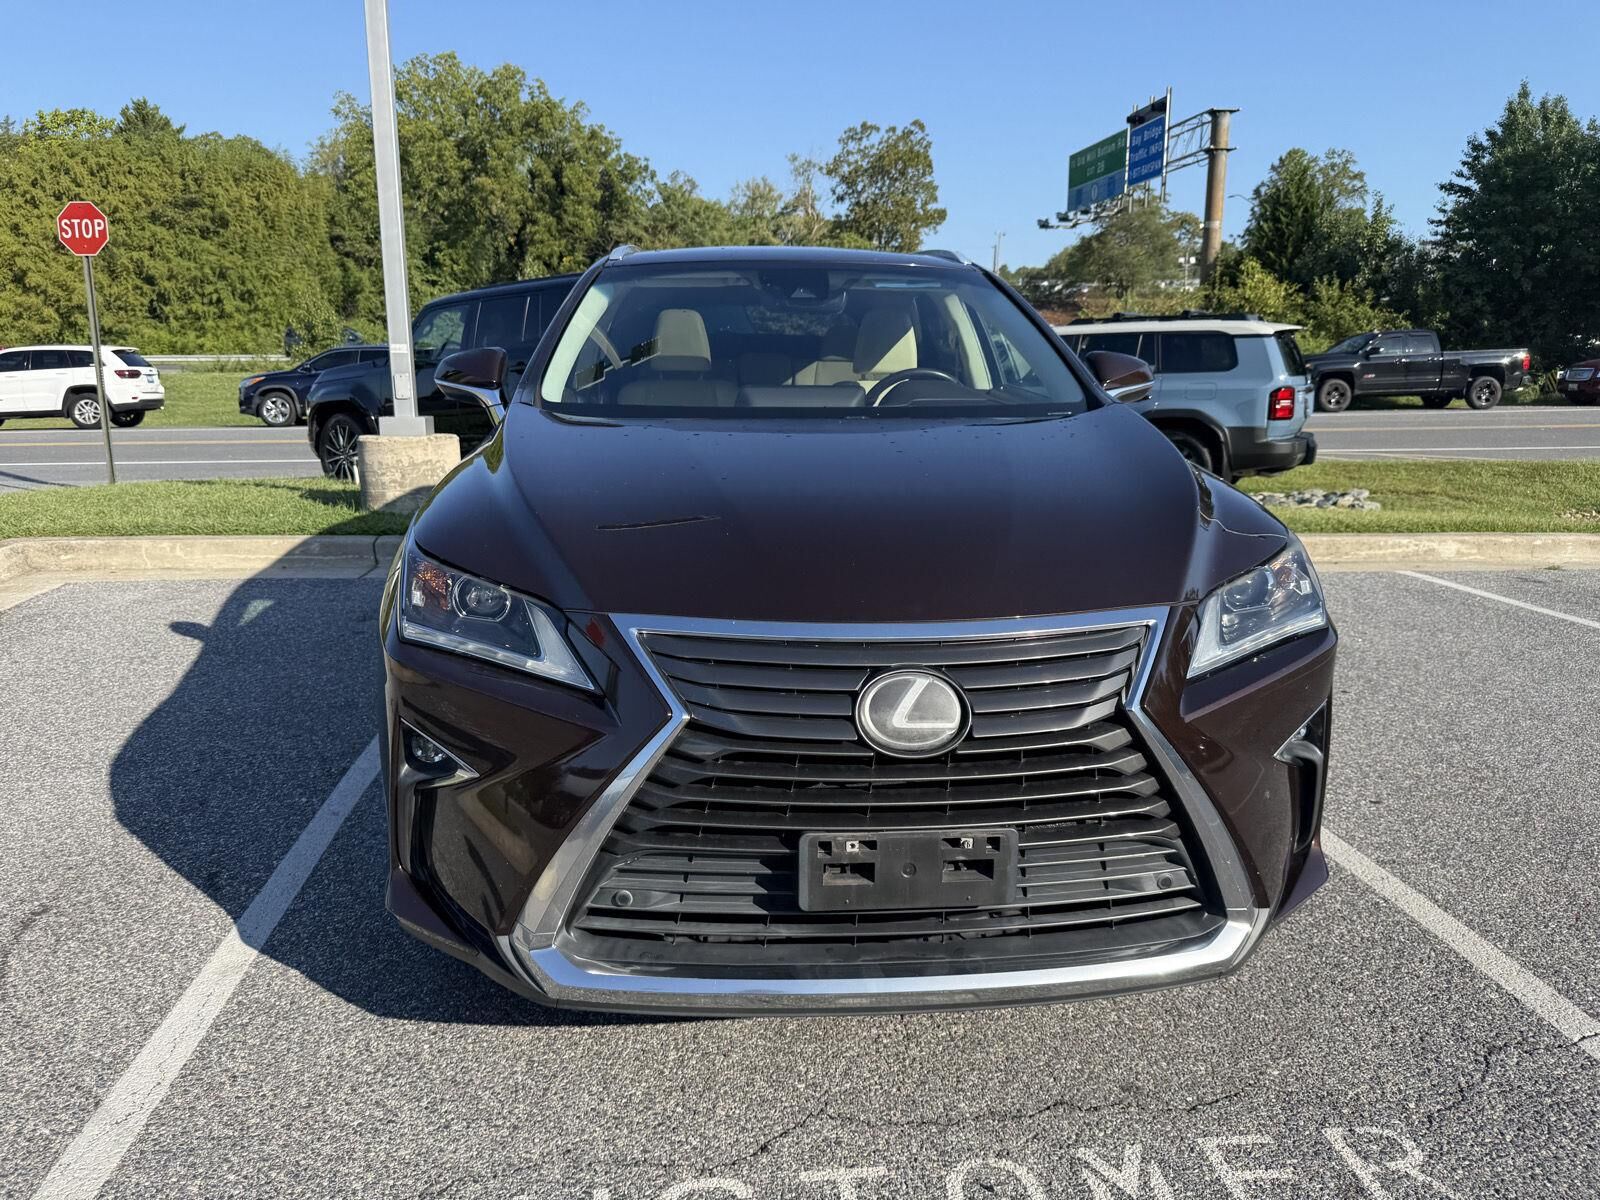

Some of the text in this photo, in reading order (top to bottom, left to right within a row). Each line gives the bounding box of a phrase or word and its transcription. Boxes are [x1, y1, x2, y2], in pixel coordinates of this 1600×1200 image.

[1143, 126, 1162, 141] Bridge
[1148, 141, 1163, 155] INFO
[61, 218, 105, 239] STOP
